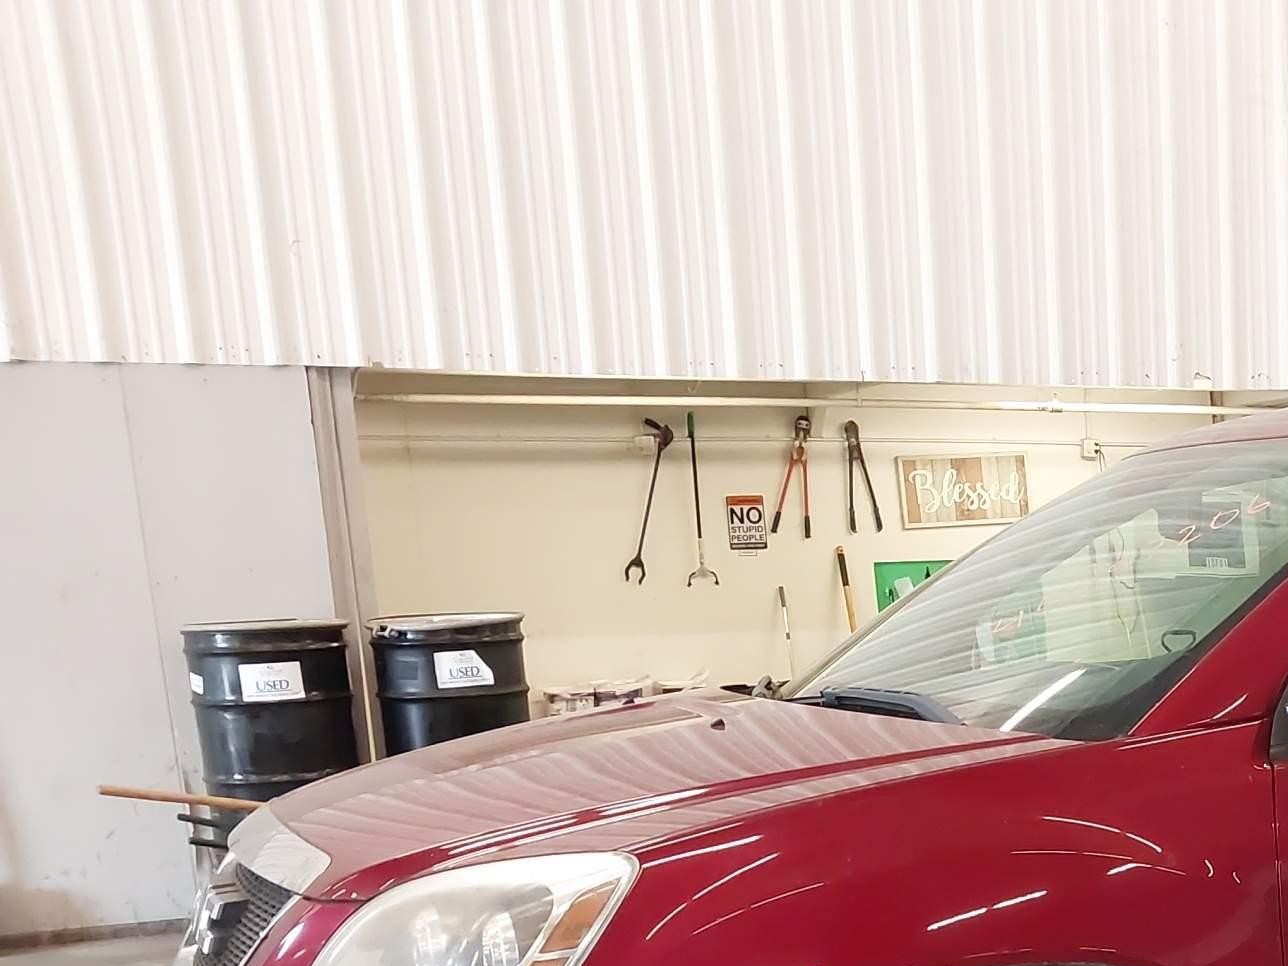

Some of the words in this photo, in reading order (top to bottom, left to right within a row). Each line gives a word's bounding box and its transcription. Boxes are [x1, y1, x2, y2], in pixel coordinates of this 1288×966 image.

[909, 469, 1024, 513] Blessed
[730, 507, 762, 524] NO
[731, 525, 764, 534] STUPID
[731, 533, 765, 542] PEOPLE
[449, 666, 480, 678] USED
[256, 680, 289, 691] USED
